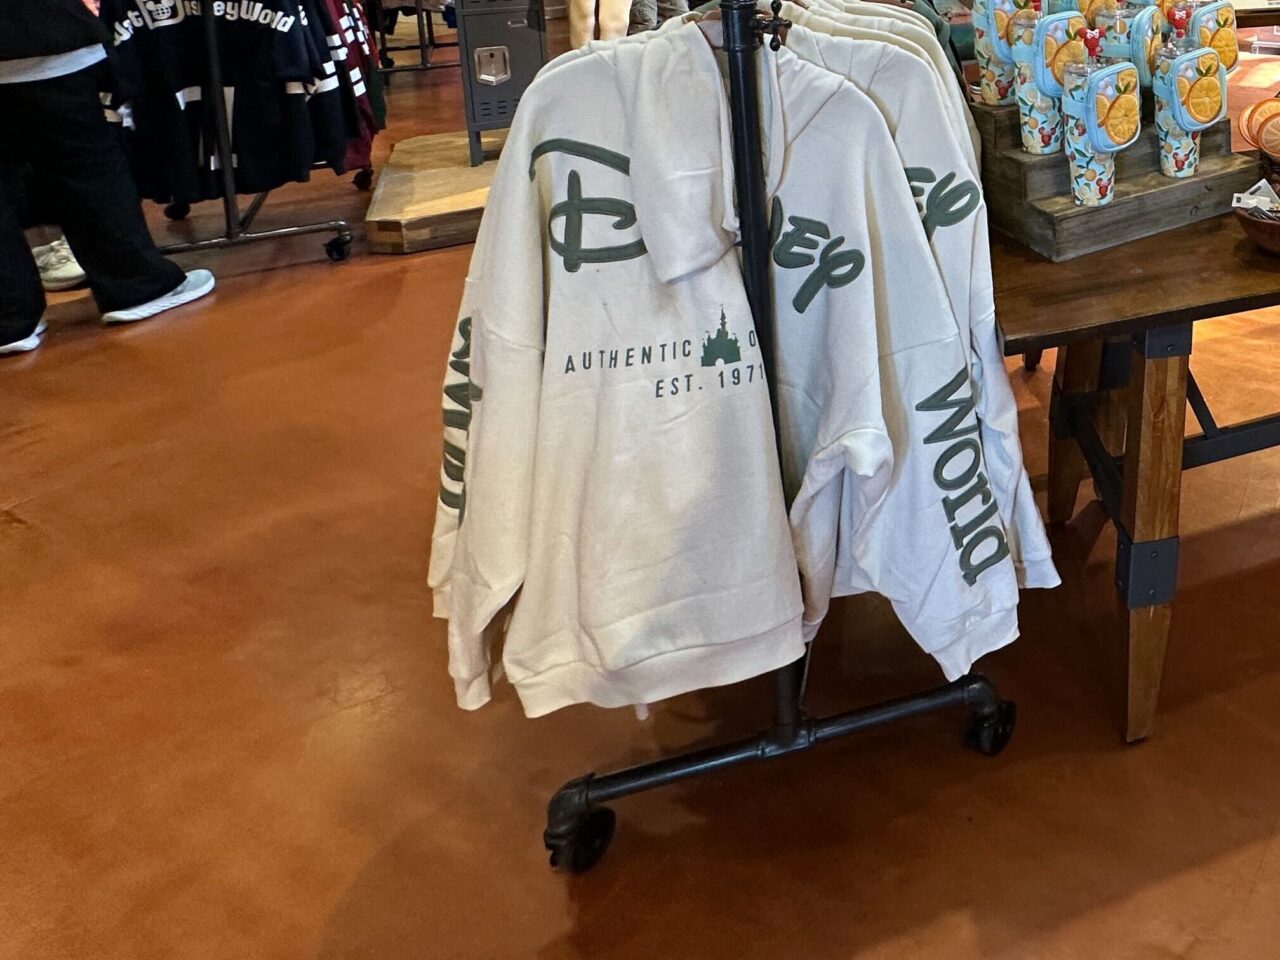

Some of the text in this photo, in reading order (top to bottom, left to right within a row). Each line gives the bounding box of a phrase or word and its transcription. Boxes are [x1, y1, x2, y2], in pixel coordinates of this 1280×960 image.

[564, 339, 692, 374] AUTHENTIC
[655, 362, 764, 398] EST. 1971
[914, 364, 1010, 587] World
